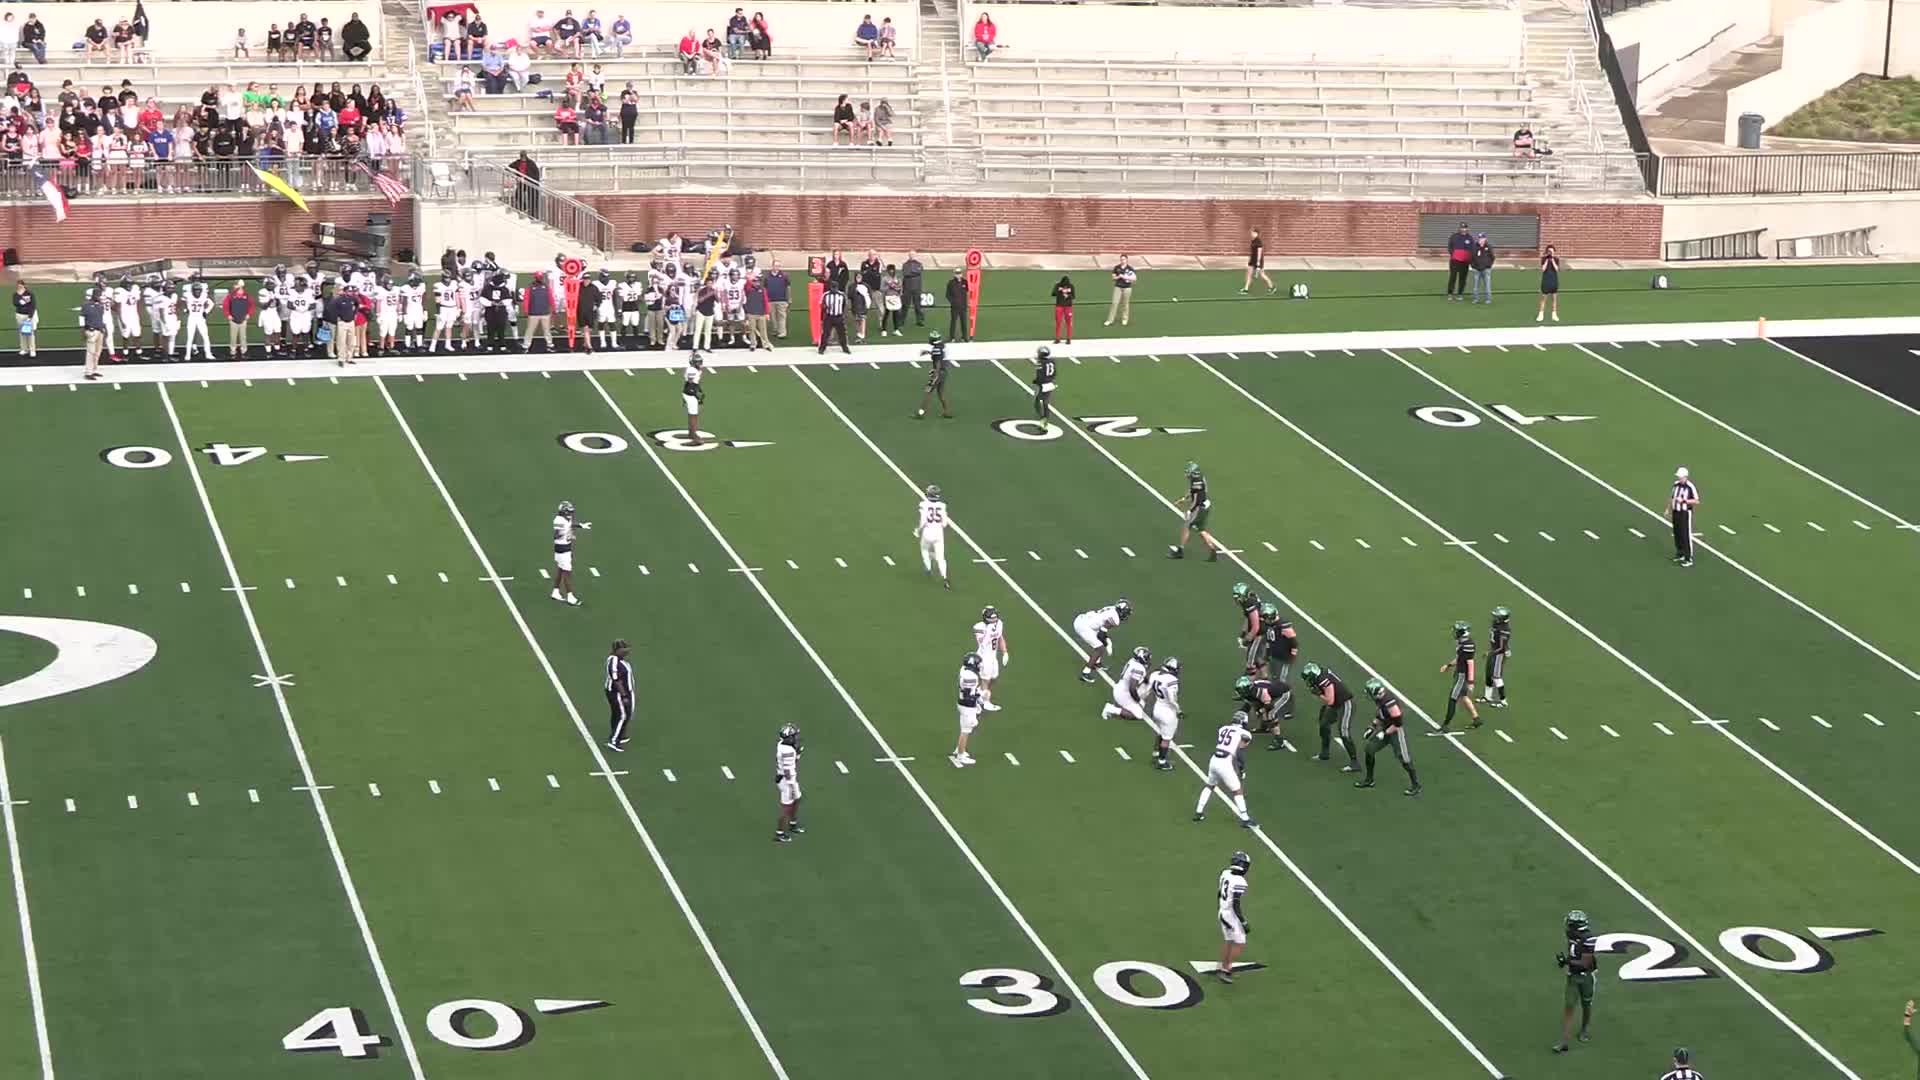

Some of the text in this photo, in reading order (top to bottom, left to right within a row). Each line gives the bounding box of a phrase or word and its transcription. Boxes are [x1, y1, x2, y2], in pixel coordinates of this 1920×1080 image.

[811, 257, 823, 274] 3
[920, 293, 934, 306] 20
[1293, 284, 1308, 297] 10
[927, 506, 943, 524] 35
[1218, 728, 1236, 747] 95
[1595, 926, 1834, 981] 20
[960, 960, 1204, 1018] 30
[282, 999, 538, 1059] 40
